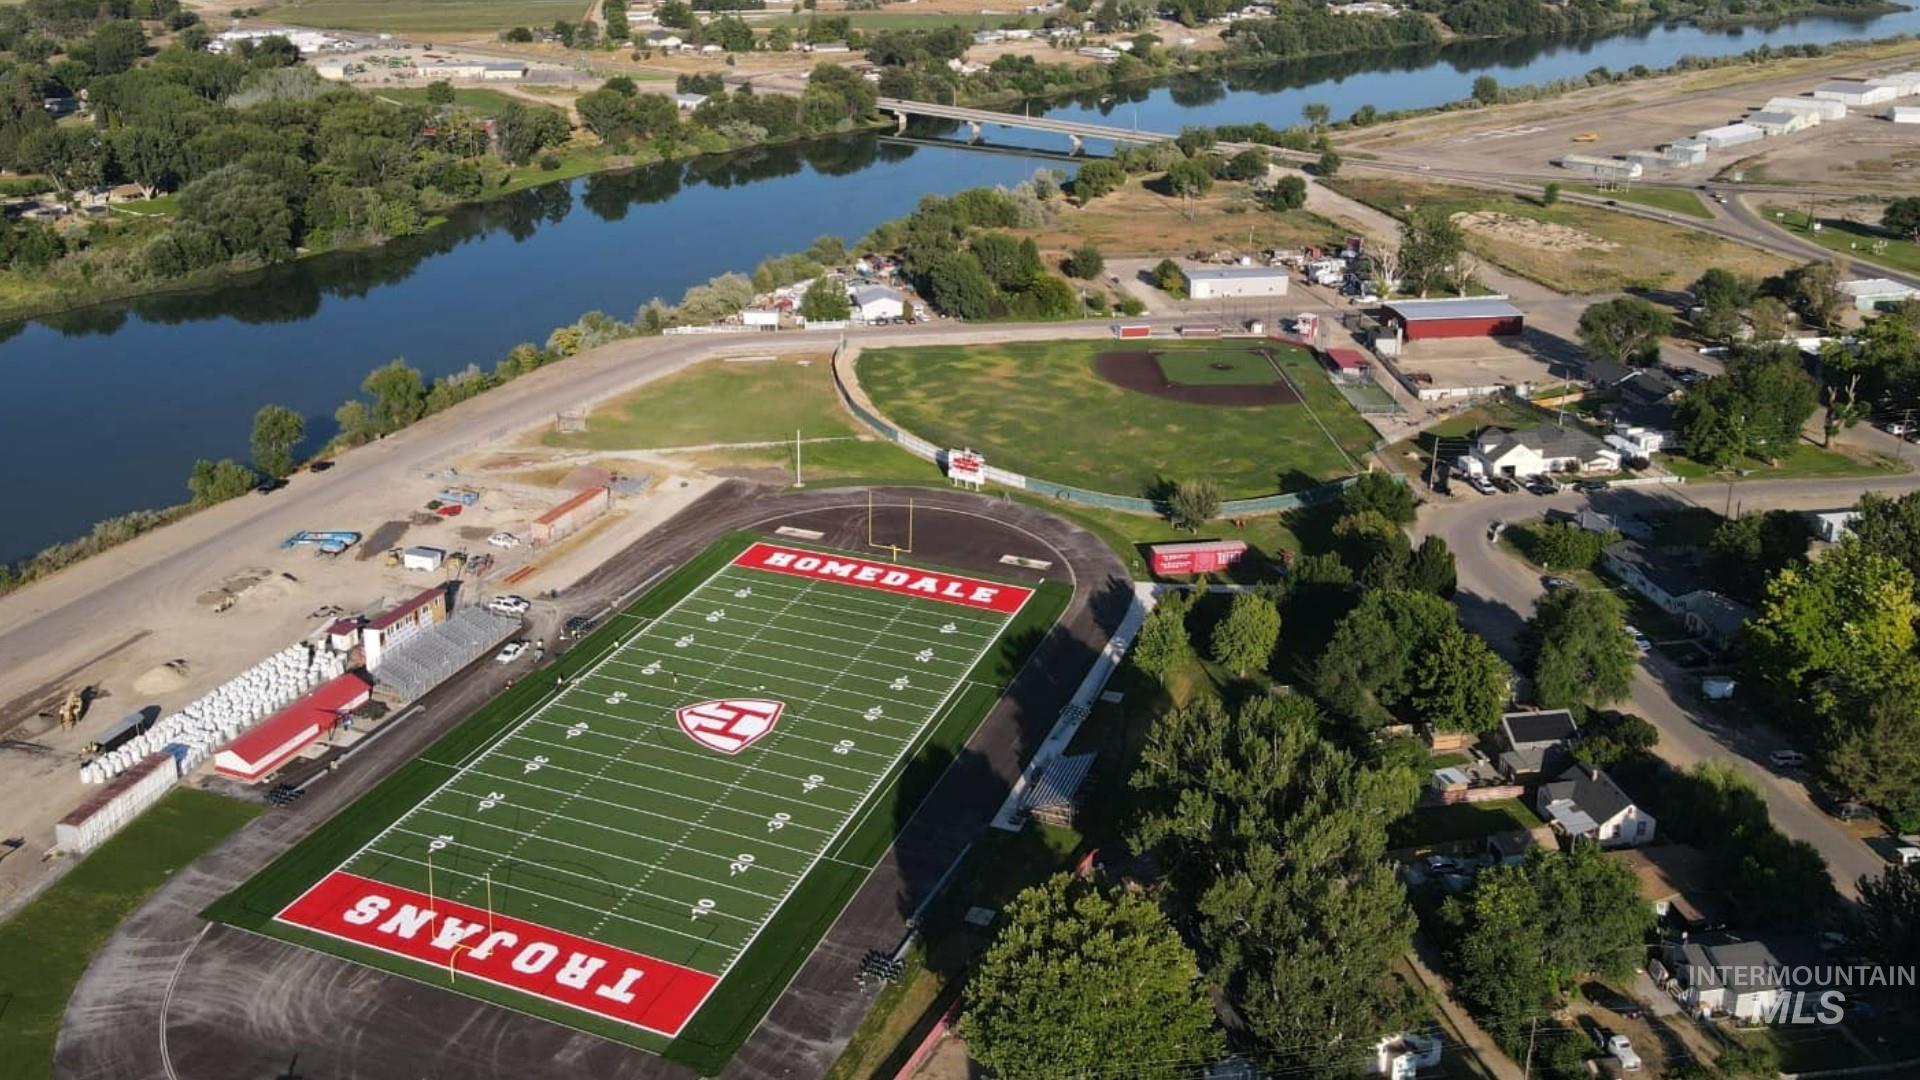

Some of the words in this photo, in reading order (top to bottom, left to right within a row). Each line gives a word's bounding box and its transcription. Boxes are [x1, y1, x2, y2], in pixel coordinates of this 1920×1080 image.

[763, 552, 999, 603] HOMEDALE
[706, 610, 725, 622] 20
[914, 650, 934, 662] 20
[832, 739, 855, 755] 50
[525, 755, 549, 771] 30
[802, 774, 825, 790] 40
[479, 792, 505, 808] 20
[767, 813, 791, 829] 30
[429, 835, 454, 849] 10
[730, 854, 755, 873] 20
[691, 899, 716, 915] 10
[343, 895, 645, 1004] TROJANS
